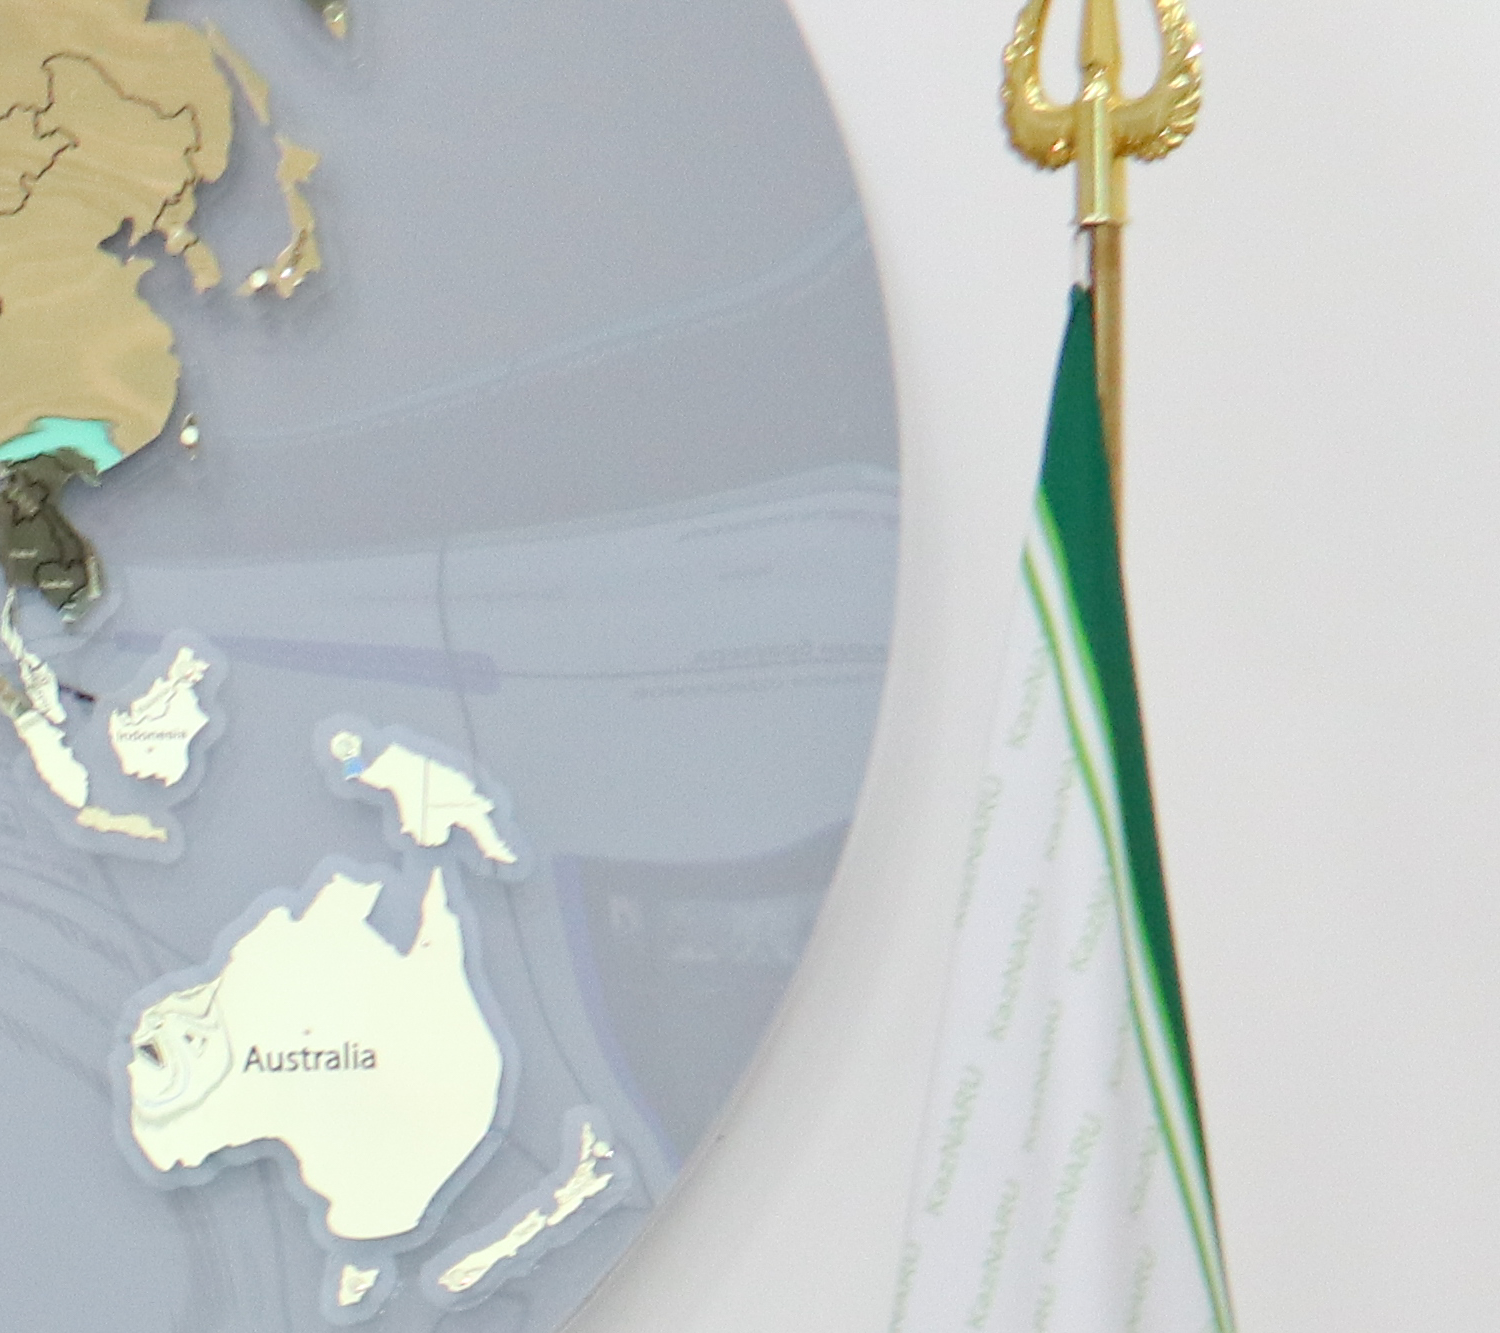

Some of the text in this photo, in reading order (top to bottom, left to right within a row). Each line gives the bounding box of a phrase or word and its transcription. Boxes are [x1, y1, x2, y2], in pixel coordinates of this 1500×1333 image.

[242, 1041, 378, 1074] Australia
[925, 1063, 984, 1215] KazNARU
[1041, 1111, 1104, 1264] KazNARU
[964, 1177, 1019, 1330] KazNARU
